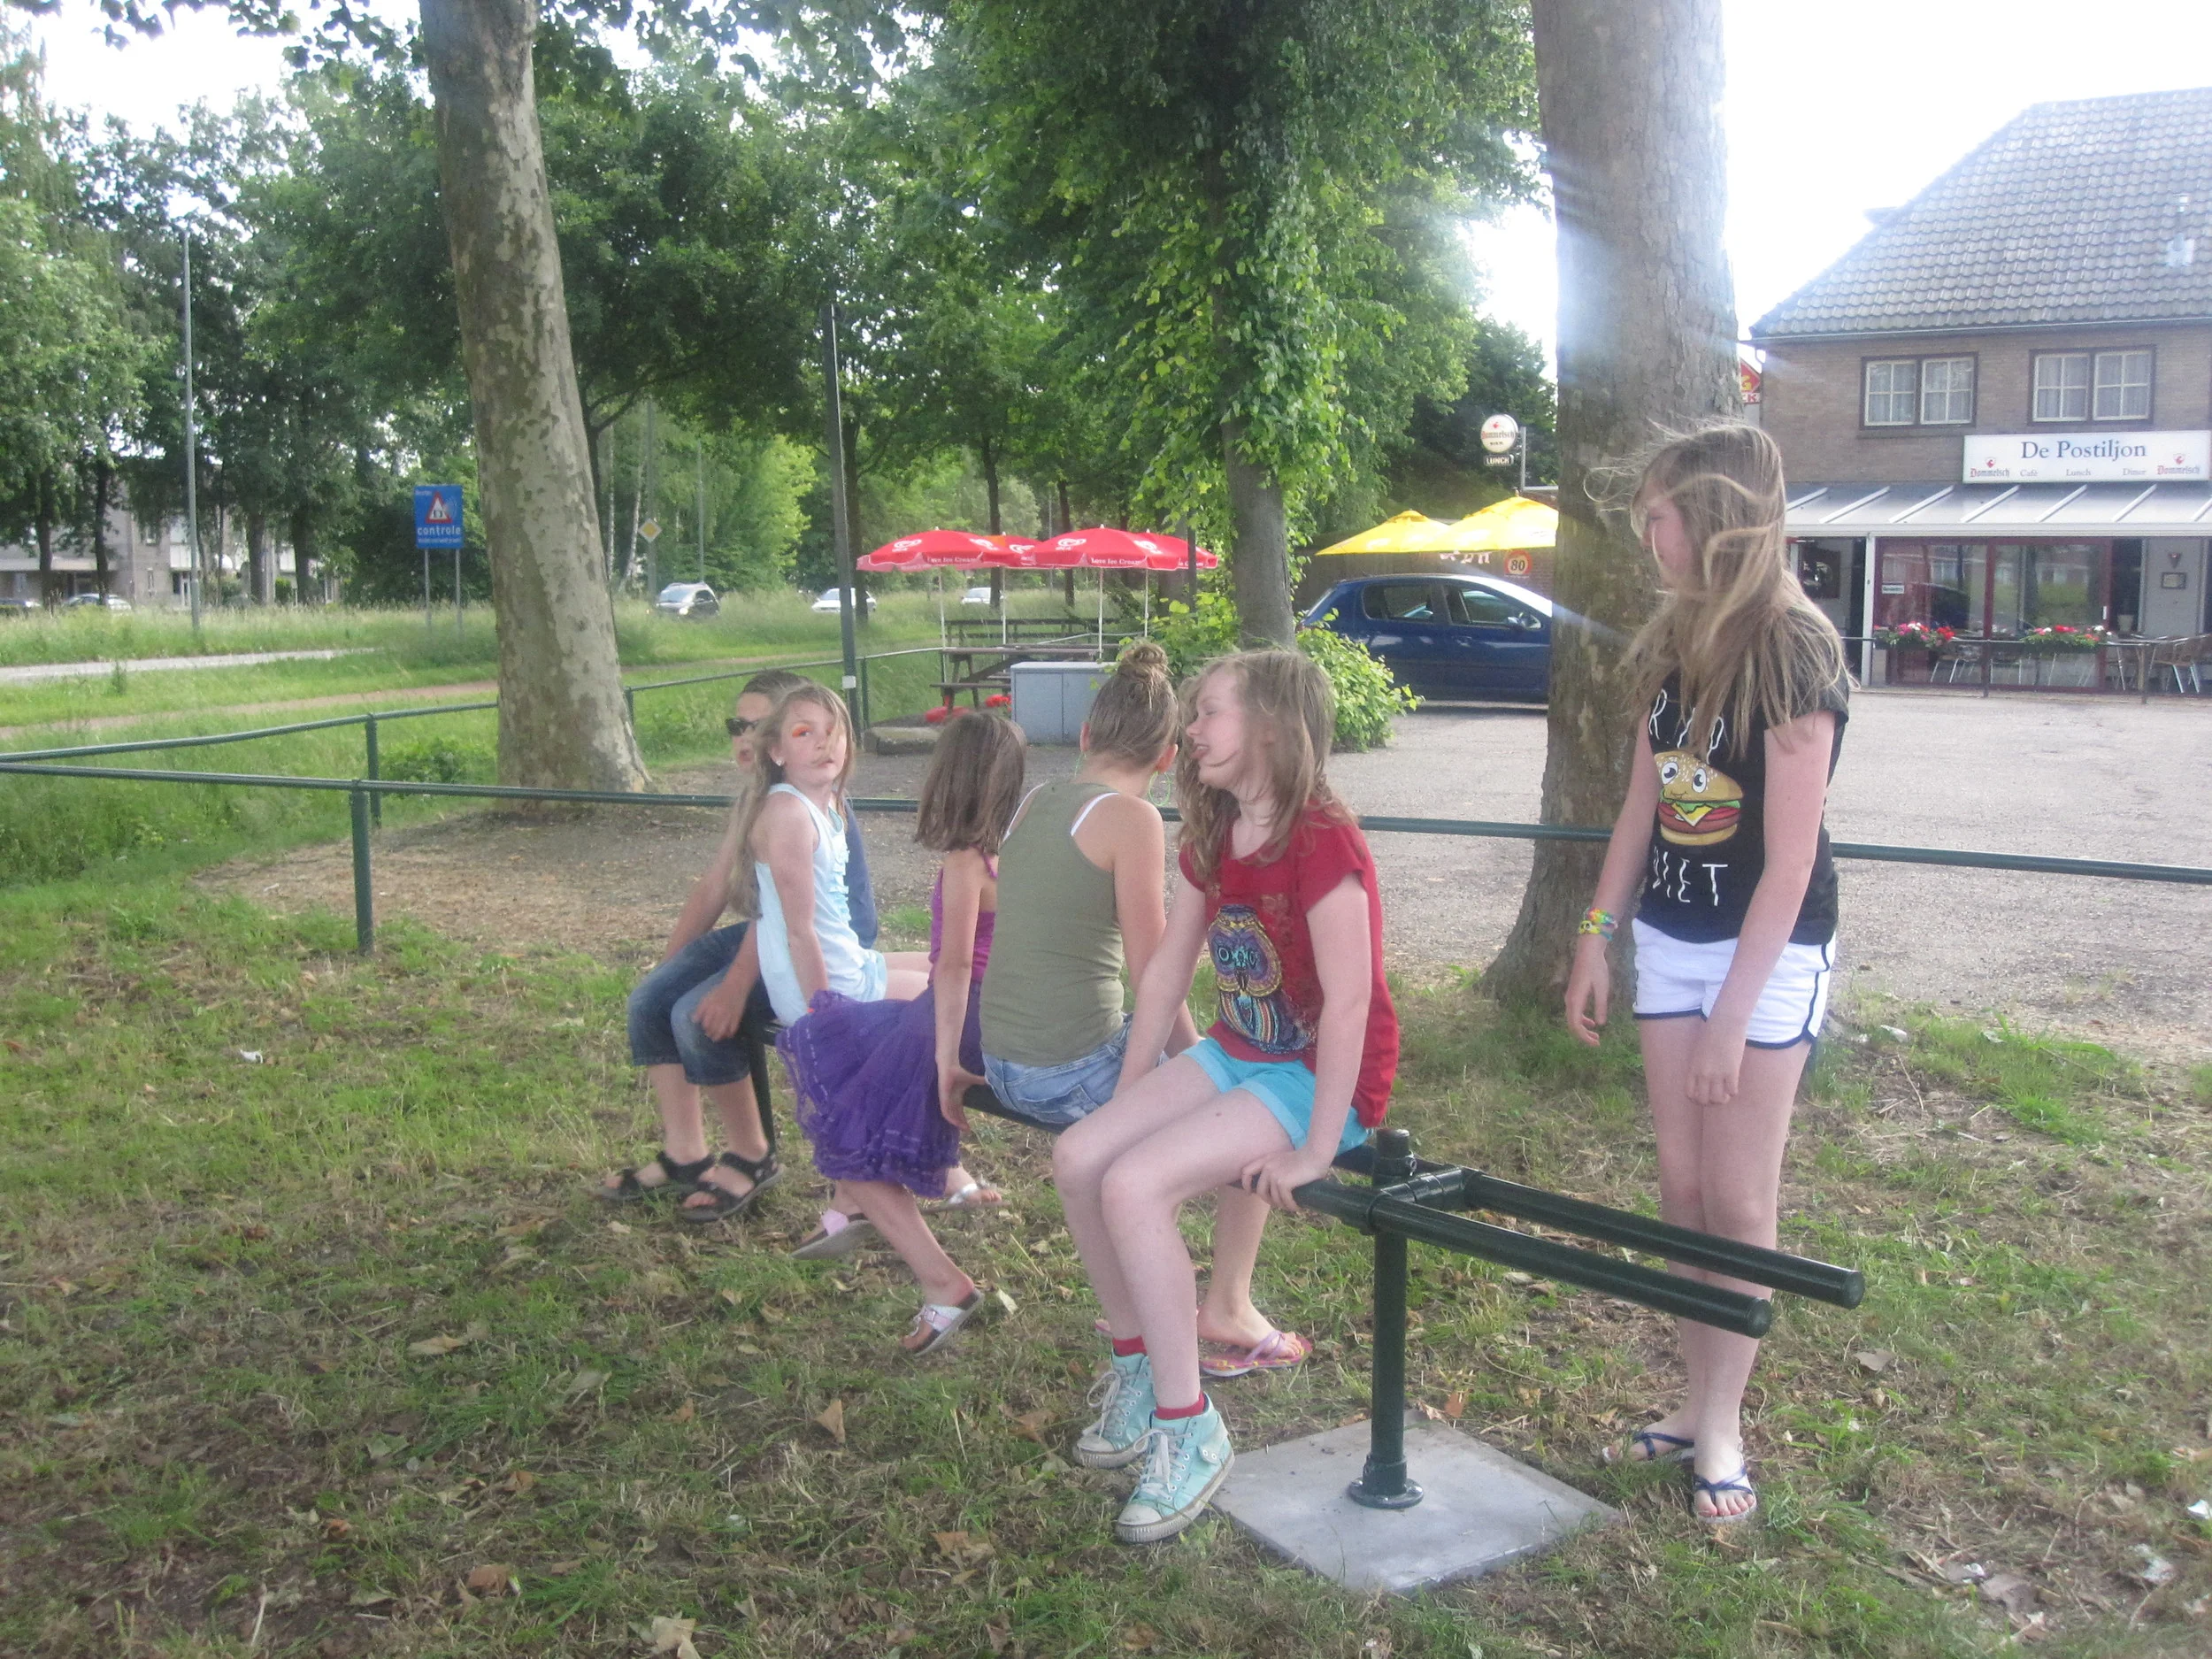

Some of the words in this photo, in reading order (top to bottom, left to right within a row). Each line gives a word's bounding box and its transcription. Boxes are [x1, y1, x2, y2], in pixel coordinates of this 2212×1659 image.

[2021, 441, 2049, 458] De
[2057, 439, 2147, 462] Postiljon
[1970, 468, 2010, 477] Dommelsch
[417, 526, 461, 535] controle
[1510, 559, 1526, 572] 80
